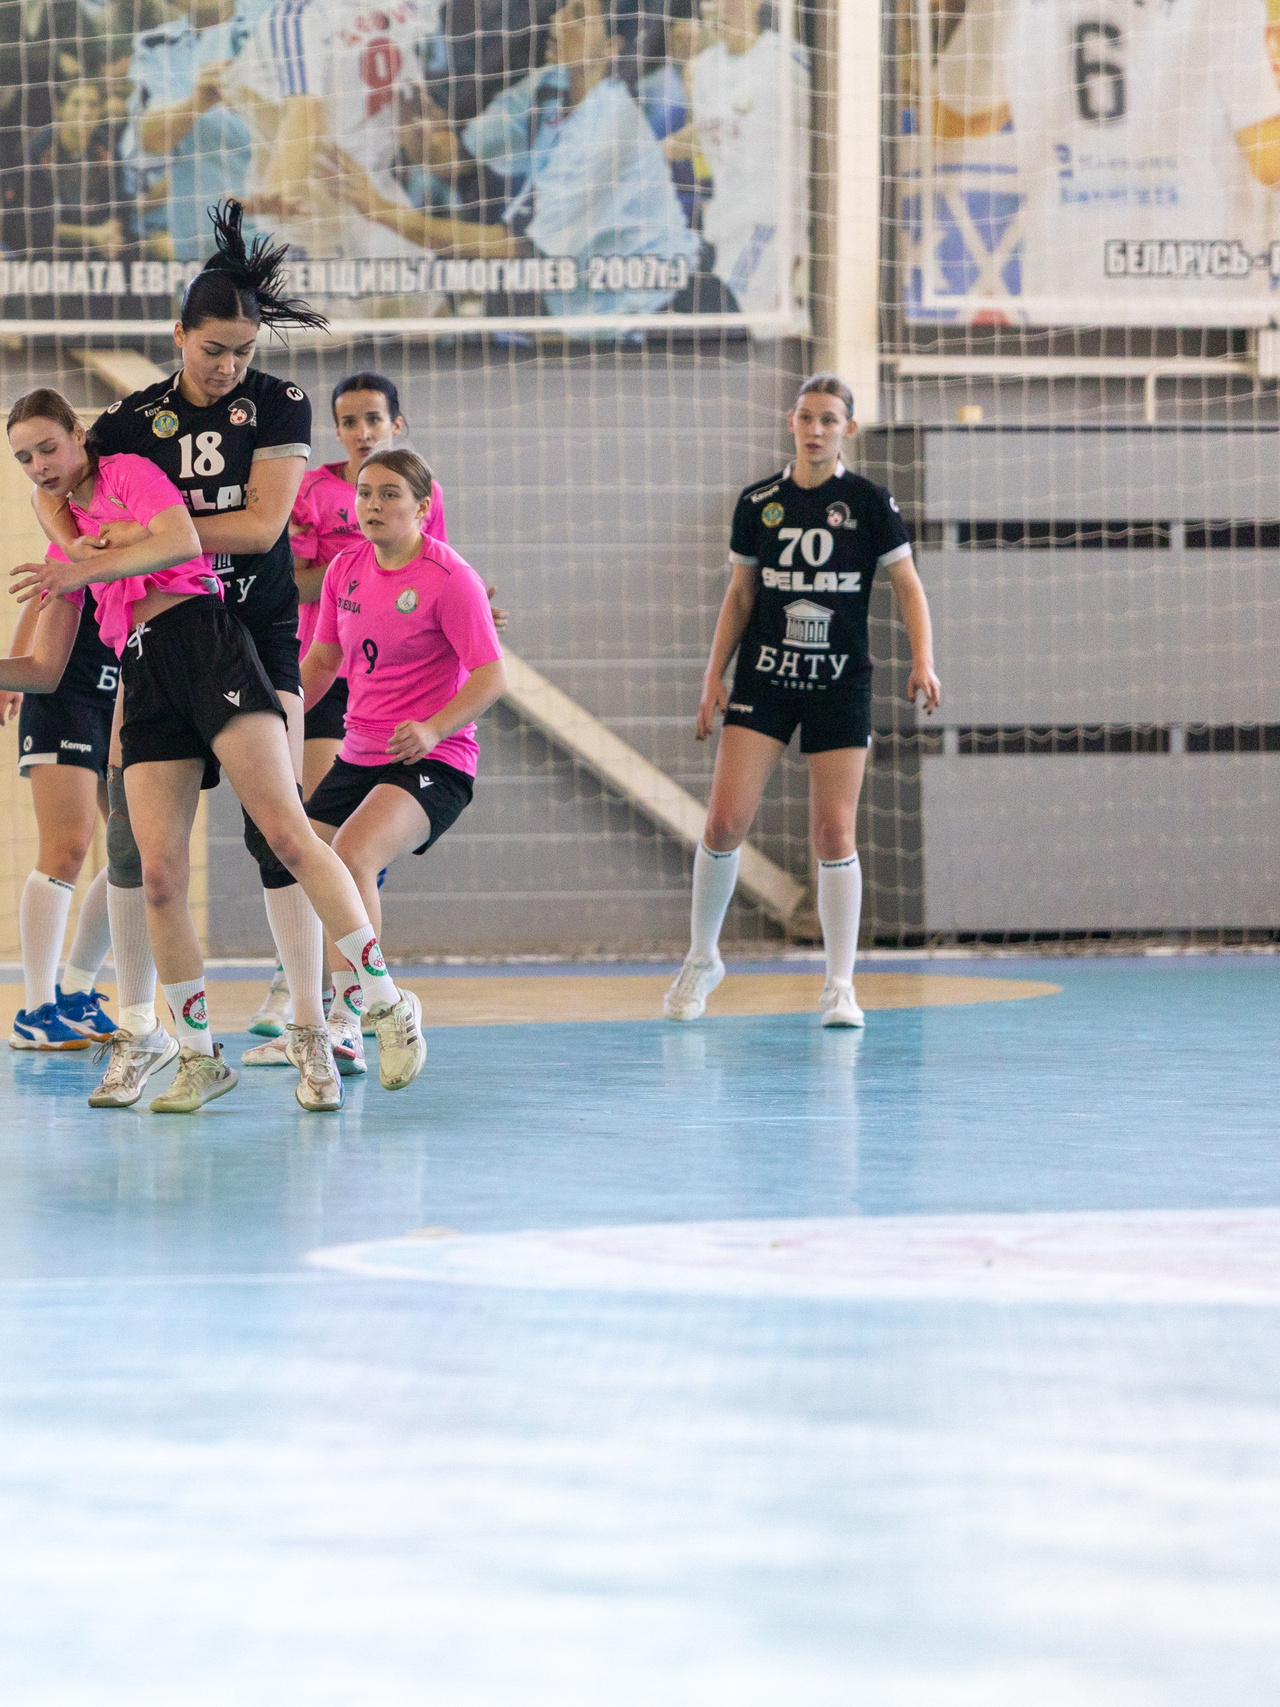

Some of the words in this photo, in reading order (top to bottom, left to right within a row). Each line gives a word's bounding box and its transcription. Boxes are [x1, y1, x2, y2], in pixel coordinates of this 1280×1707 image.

[178, 431, 225, 478] 18
[778, 527, 834, 567] 70
[362, 638, 378, 674] 9
[755, 645, 849, 681] БНТУ
[60, 739, 93, 753] Kempa
